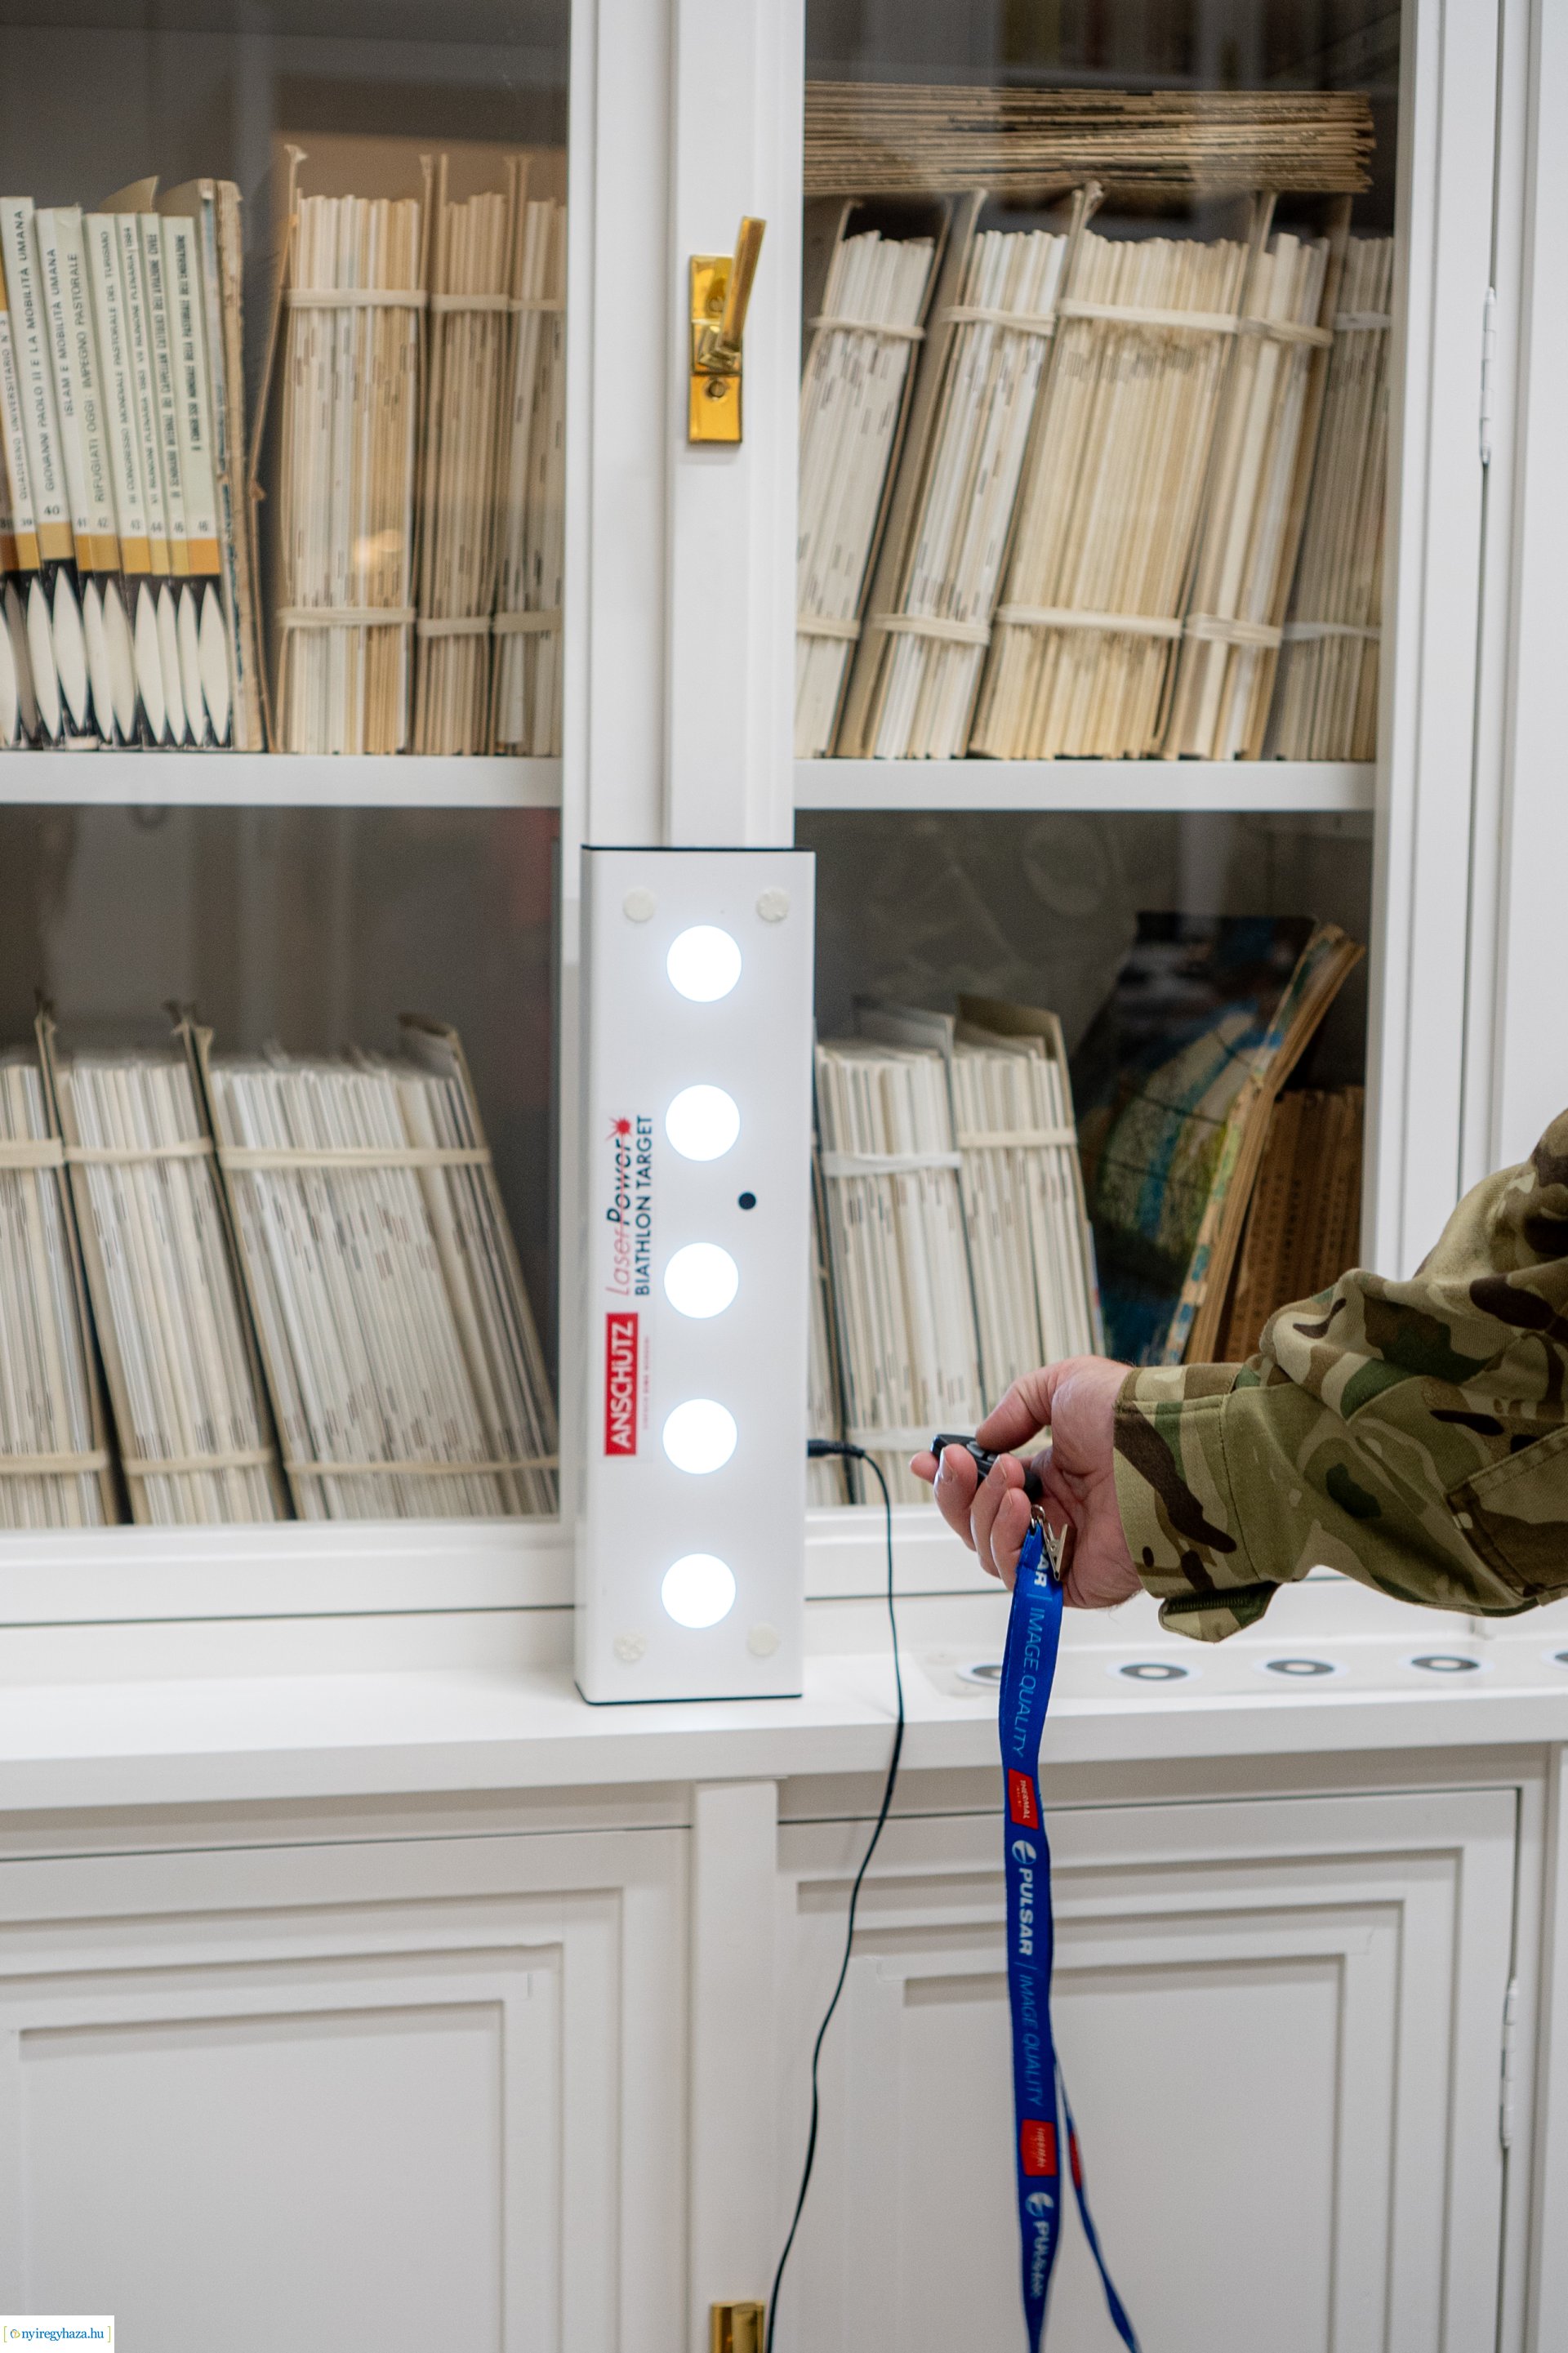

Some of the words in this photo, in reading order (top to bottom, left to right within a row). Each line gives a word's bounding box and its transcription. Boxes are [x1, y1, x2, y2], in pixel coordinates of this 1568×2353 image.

[14, 211, 27, 261] UMANA
[100, 230, 113, 279] TURISMO
[18, 268, 36, 329] MOBILITÀ
[47, 248, 60, 296] UMANA
[68, 253, 85, 326] PASTORALE
[106, 285, 115, 302] DEL
[28, 335, 38, 353] LA
[52, 301, 67, 359] MOBILITÀ
[108, 307, 122, 366] PASTORALE
[32, 372, 42, 381] II
[76, 332, 91, 389] IMPEGNO
[2, 349, 19, 432] UNIVERSITARIO
[34, 386, 47, 427] PAOLO
[60, 378, 74, 417] ISLAM
[13, 437, 27, 500] QUADERNO
[38, 432, 55, 490] GIOVANNI
[88, 439, 105, 502] RIFUGIATI
[122, 428, 135, 491] CONGRESSO
[44, 506, 59, 515] 40
[635, 1116, 652, 1190] TARGET
[635, 1196, 651, 1295] BIATHLON
[1024, 1607, 1045, 1670] IMAGE
[1013, 1675, 1036, 1758] QUALITY
[1018, 1868, 1034, 1955] PULSAR
[1018, 1974, 1039, 2029] IMAGE
[1022, 2034, 1044, 2107] QUALITY
